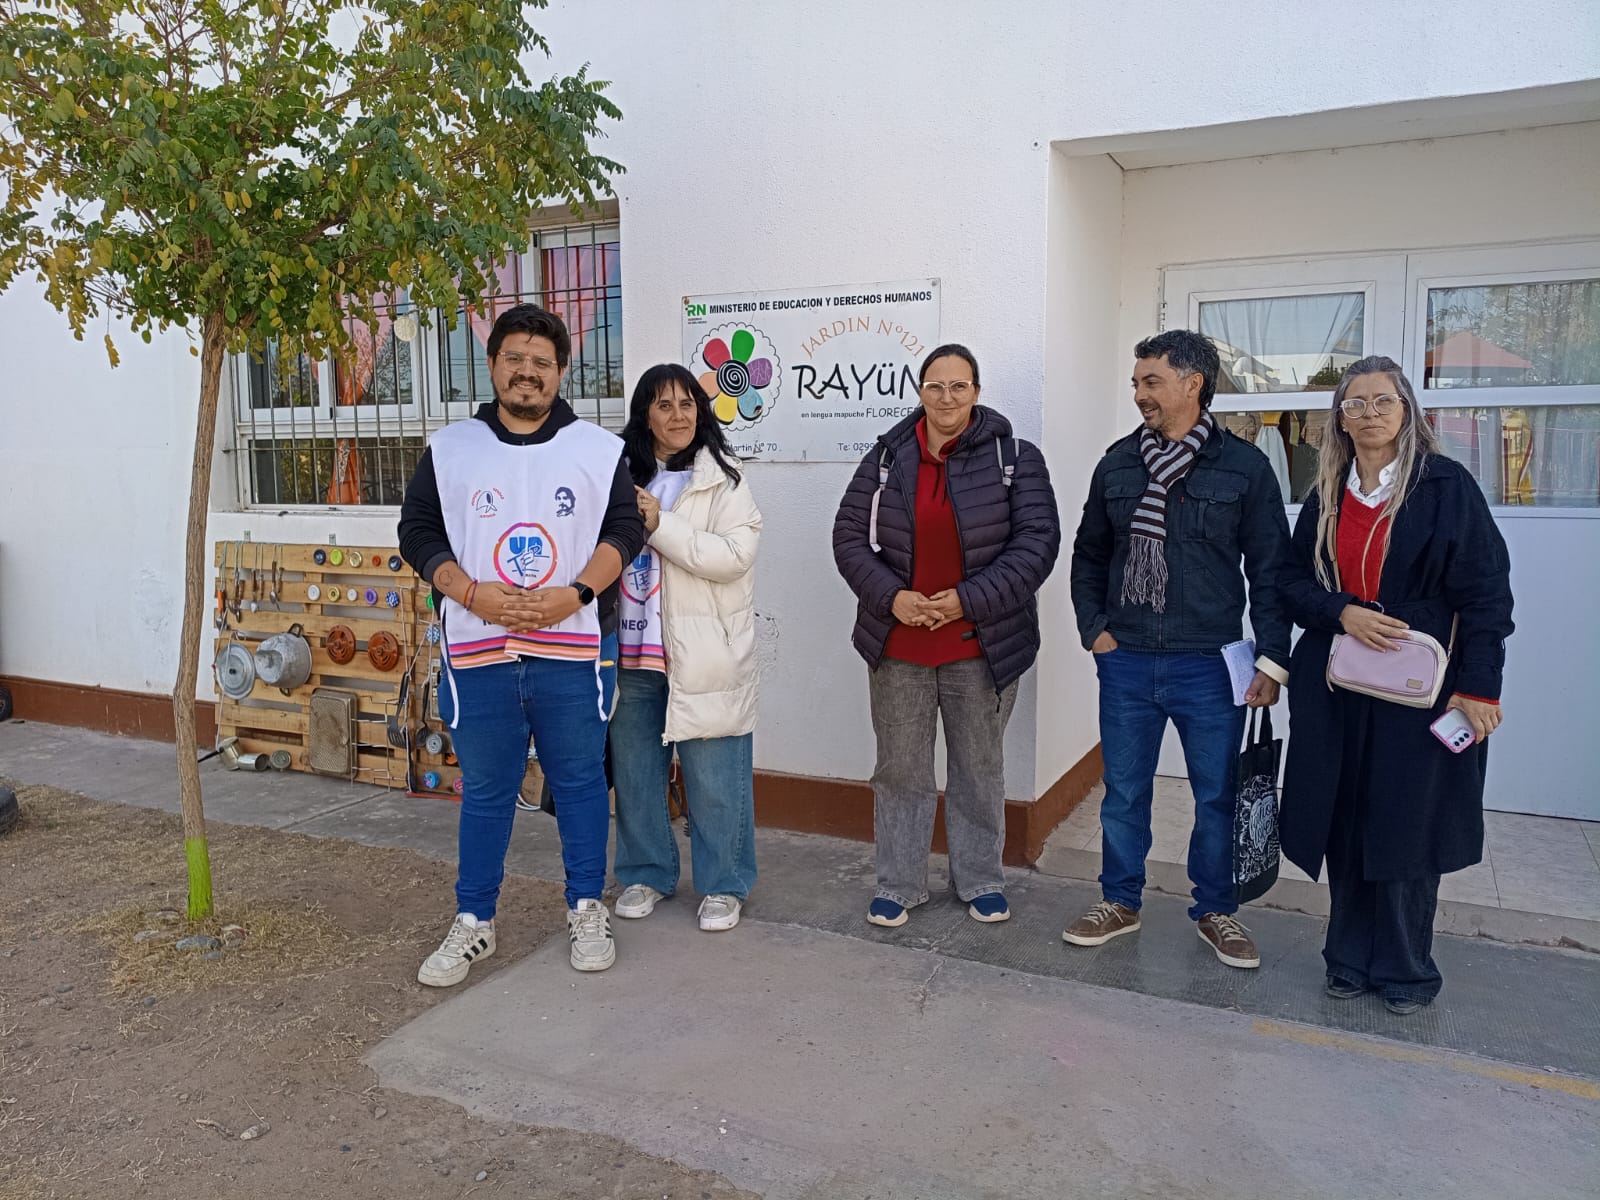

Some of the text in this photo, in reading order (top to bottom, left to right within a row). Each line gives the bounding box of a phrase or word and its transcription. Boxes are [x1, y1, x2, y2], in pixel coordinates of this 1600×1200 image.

[709, 291, 932, 314] MINISTERIO DE EDUCACION Y DERECHOS HUMANOS
[687, 303, 707, 317] RN
[801, 316, 870, 359] JARDIN
[810, 411, 833, 420] lengua
[833, 411, 865, 419] mapuche
[767, 442, 778, 452] 70
